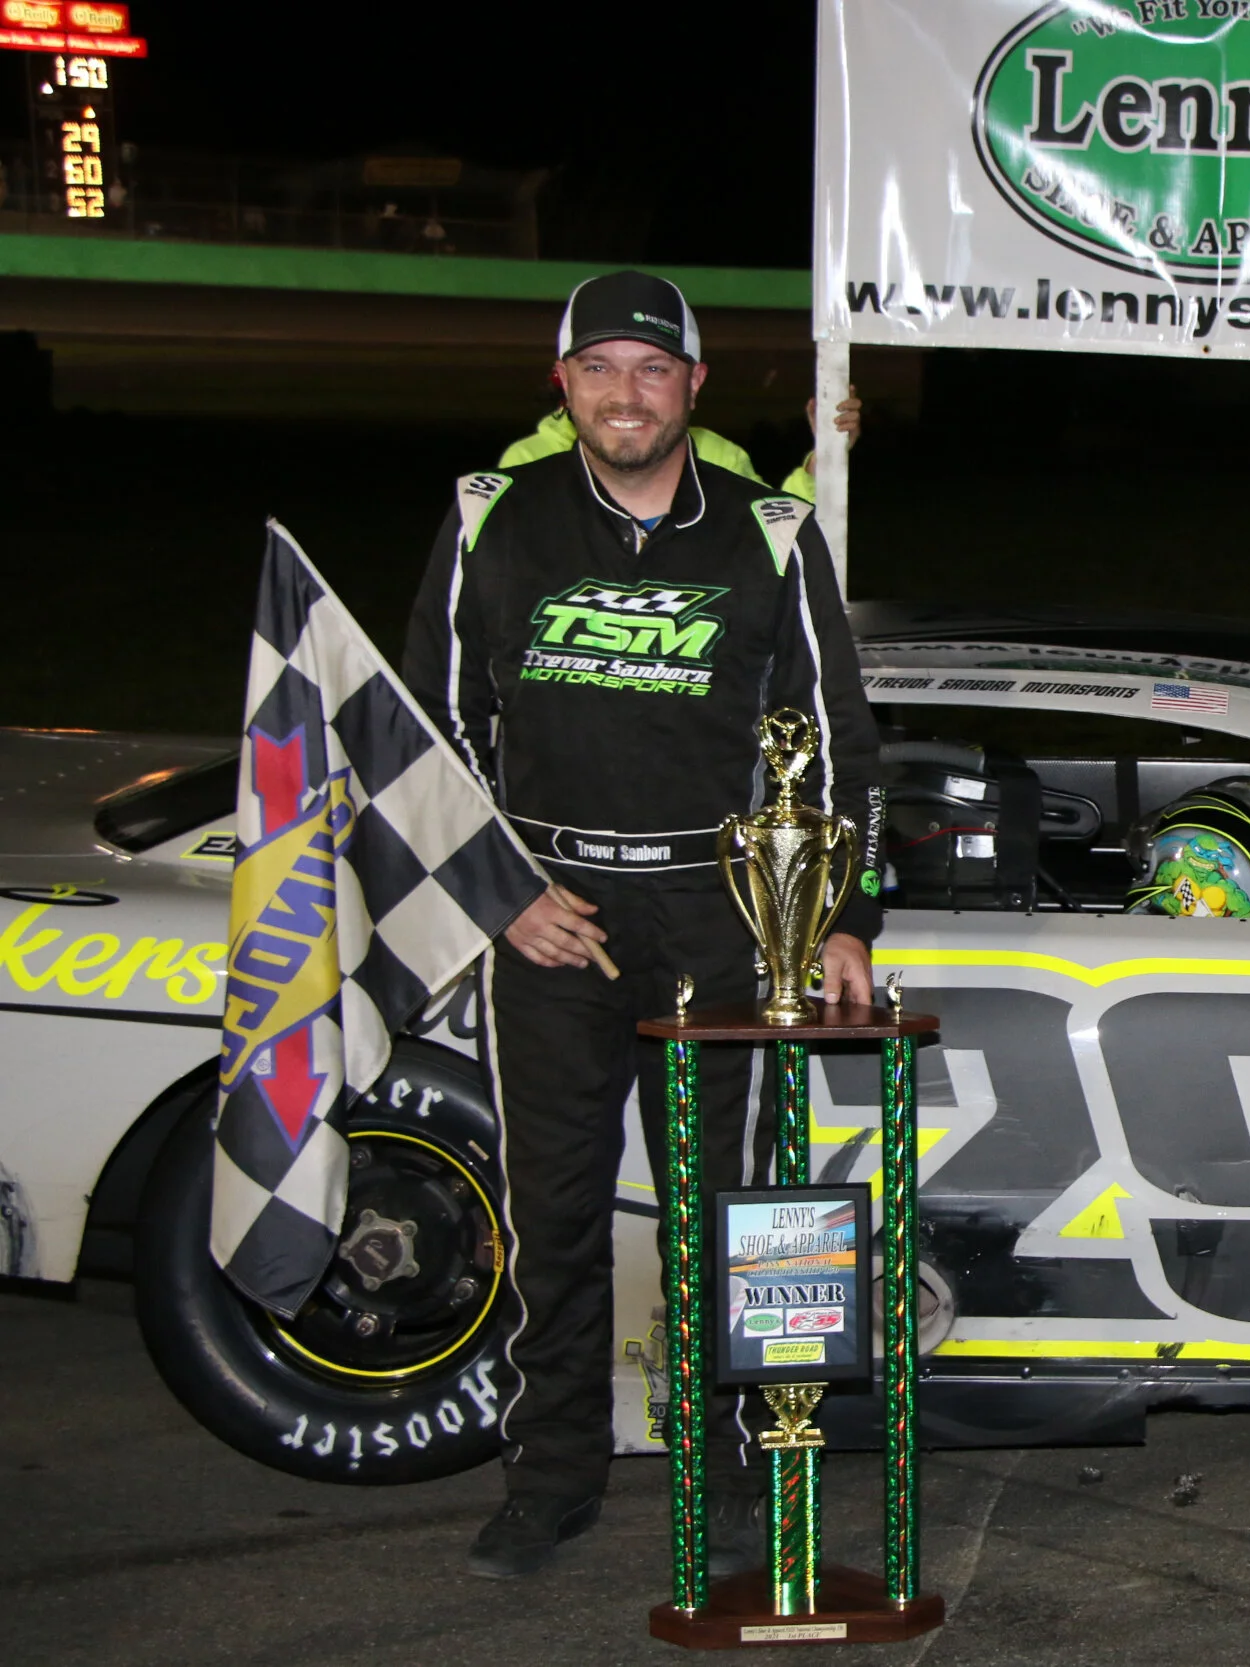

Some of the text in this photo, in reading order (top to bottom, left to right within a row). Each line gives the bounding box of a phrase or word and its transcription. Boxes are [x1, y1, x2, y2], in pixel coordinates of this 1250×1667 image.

[1140, 0, 1187, 24] Fit
[55, 55, 108, 88] 150
[62, 122, 100, 152] 29
[64, 155, 103, 185] 60
[66, 187, 104, 217] 52
[1147, 214, 1182, 252] &
[542, 604, 718, 658] TSM
[523, 650, 713, 683] Trevor Sanborn
[520, 667, 711, 696] MOTORSPORTS
[872, 677, 1140, 699] TREVOR SANBORN MOTORSPORTS
[576, 840, 671, 861] Trevor Sanborn
[772, 1207, 815, 1229] LENNY'S
[739, 1231, 847, 1256] SHOE & APPAREL
[744, 1283, 845, 1306] WINNER
[768, 1344, 819, 1354] THUNDER ROAD
[281, 1358, 499, 1470] Hoosier
